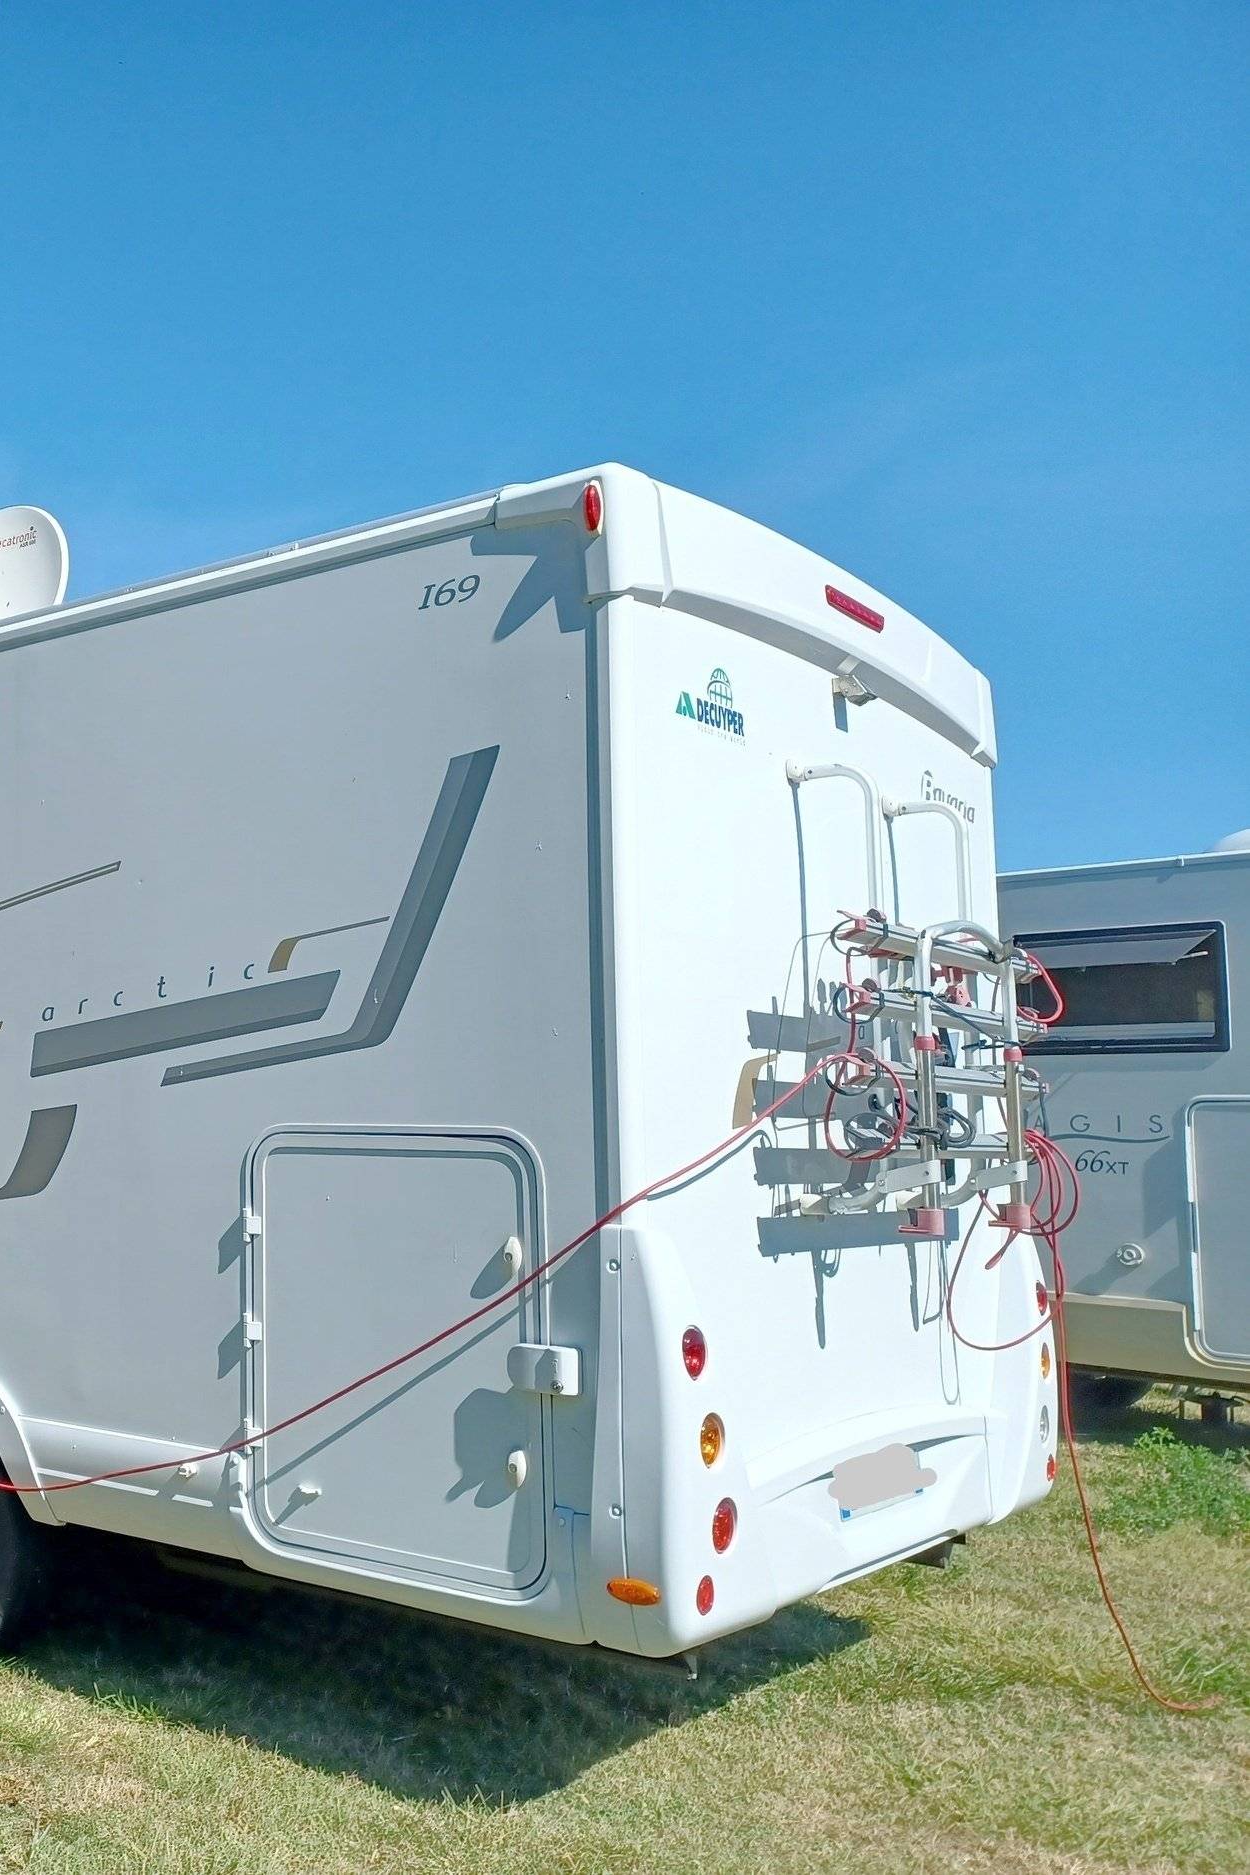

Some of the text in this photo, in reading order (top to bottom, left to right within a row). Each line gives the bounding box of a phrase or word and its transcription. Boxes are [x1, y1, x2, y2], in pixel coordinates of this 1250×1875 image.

[418, 574, 481, 610] I69
[697, 697, 745, 737] DECUYPER
[41, 963, 255, 1022] arctic
[1075, 1150, 1129, 1175] 66XT
